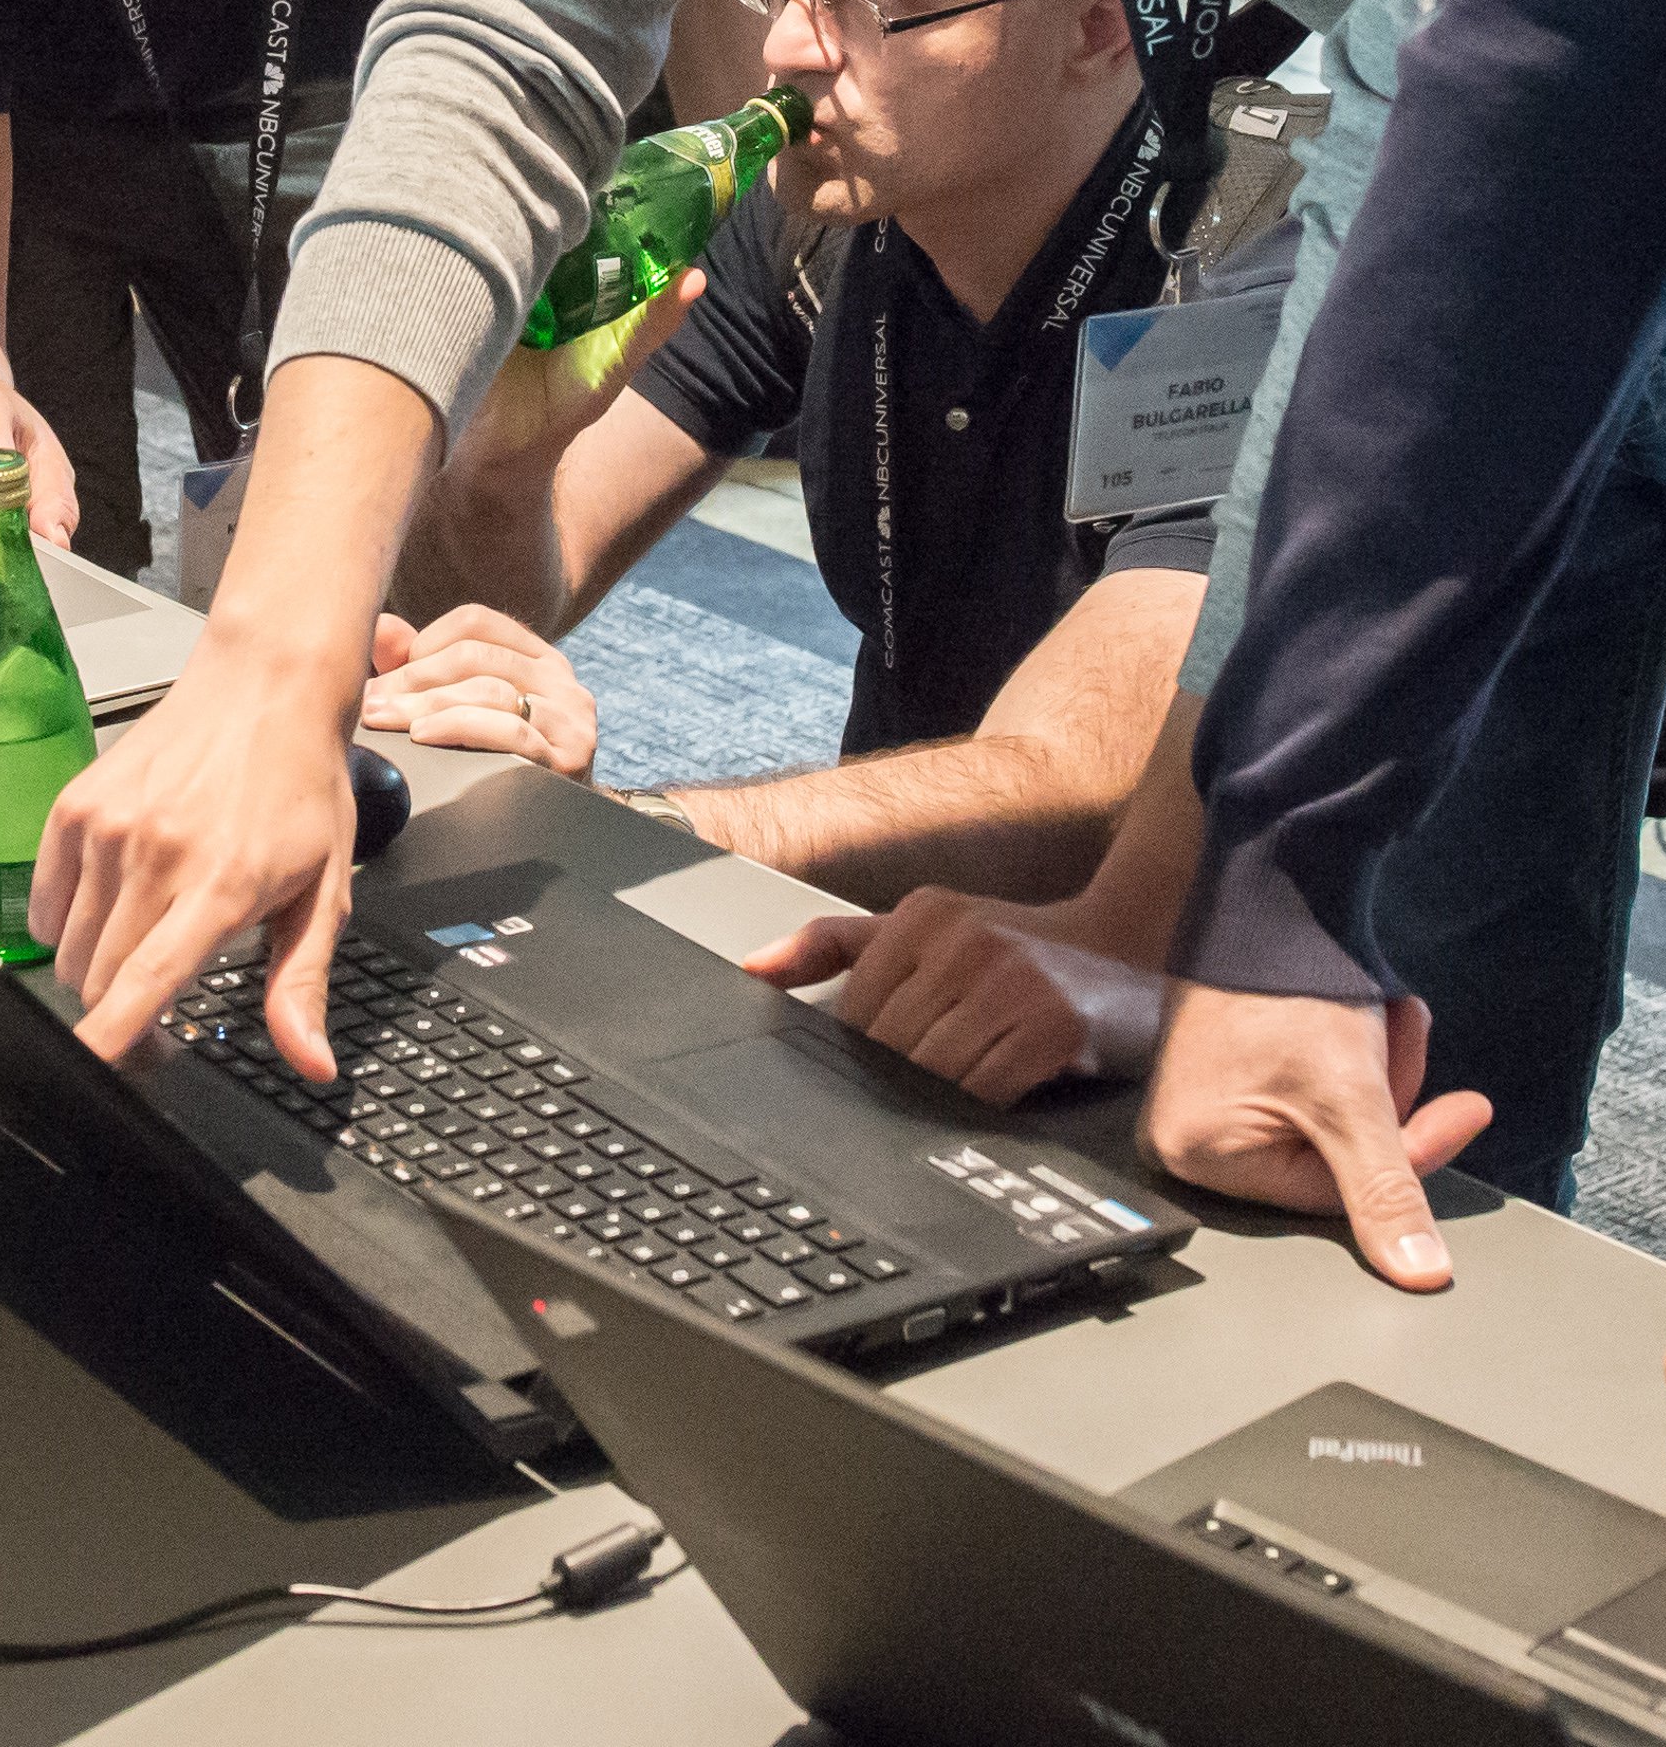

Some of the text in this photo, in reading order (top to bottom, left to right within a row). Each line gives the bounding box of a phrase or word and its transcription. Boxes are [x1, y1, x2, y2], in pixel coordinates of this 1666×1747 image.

[1042, 161, 1151, 332] NBCUNIVERSAL
[1168, 377, 1226, 400] FABIO
[1132, 397, 1254, 430] BULGARELLA
[876, 313, 896, 670] COMCAST NBCUNIVERSAL
[1101, 470, 1134, 489] 105
